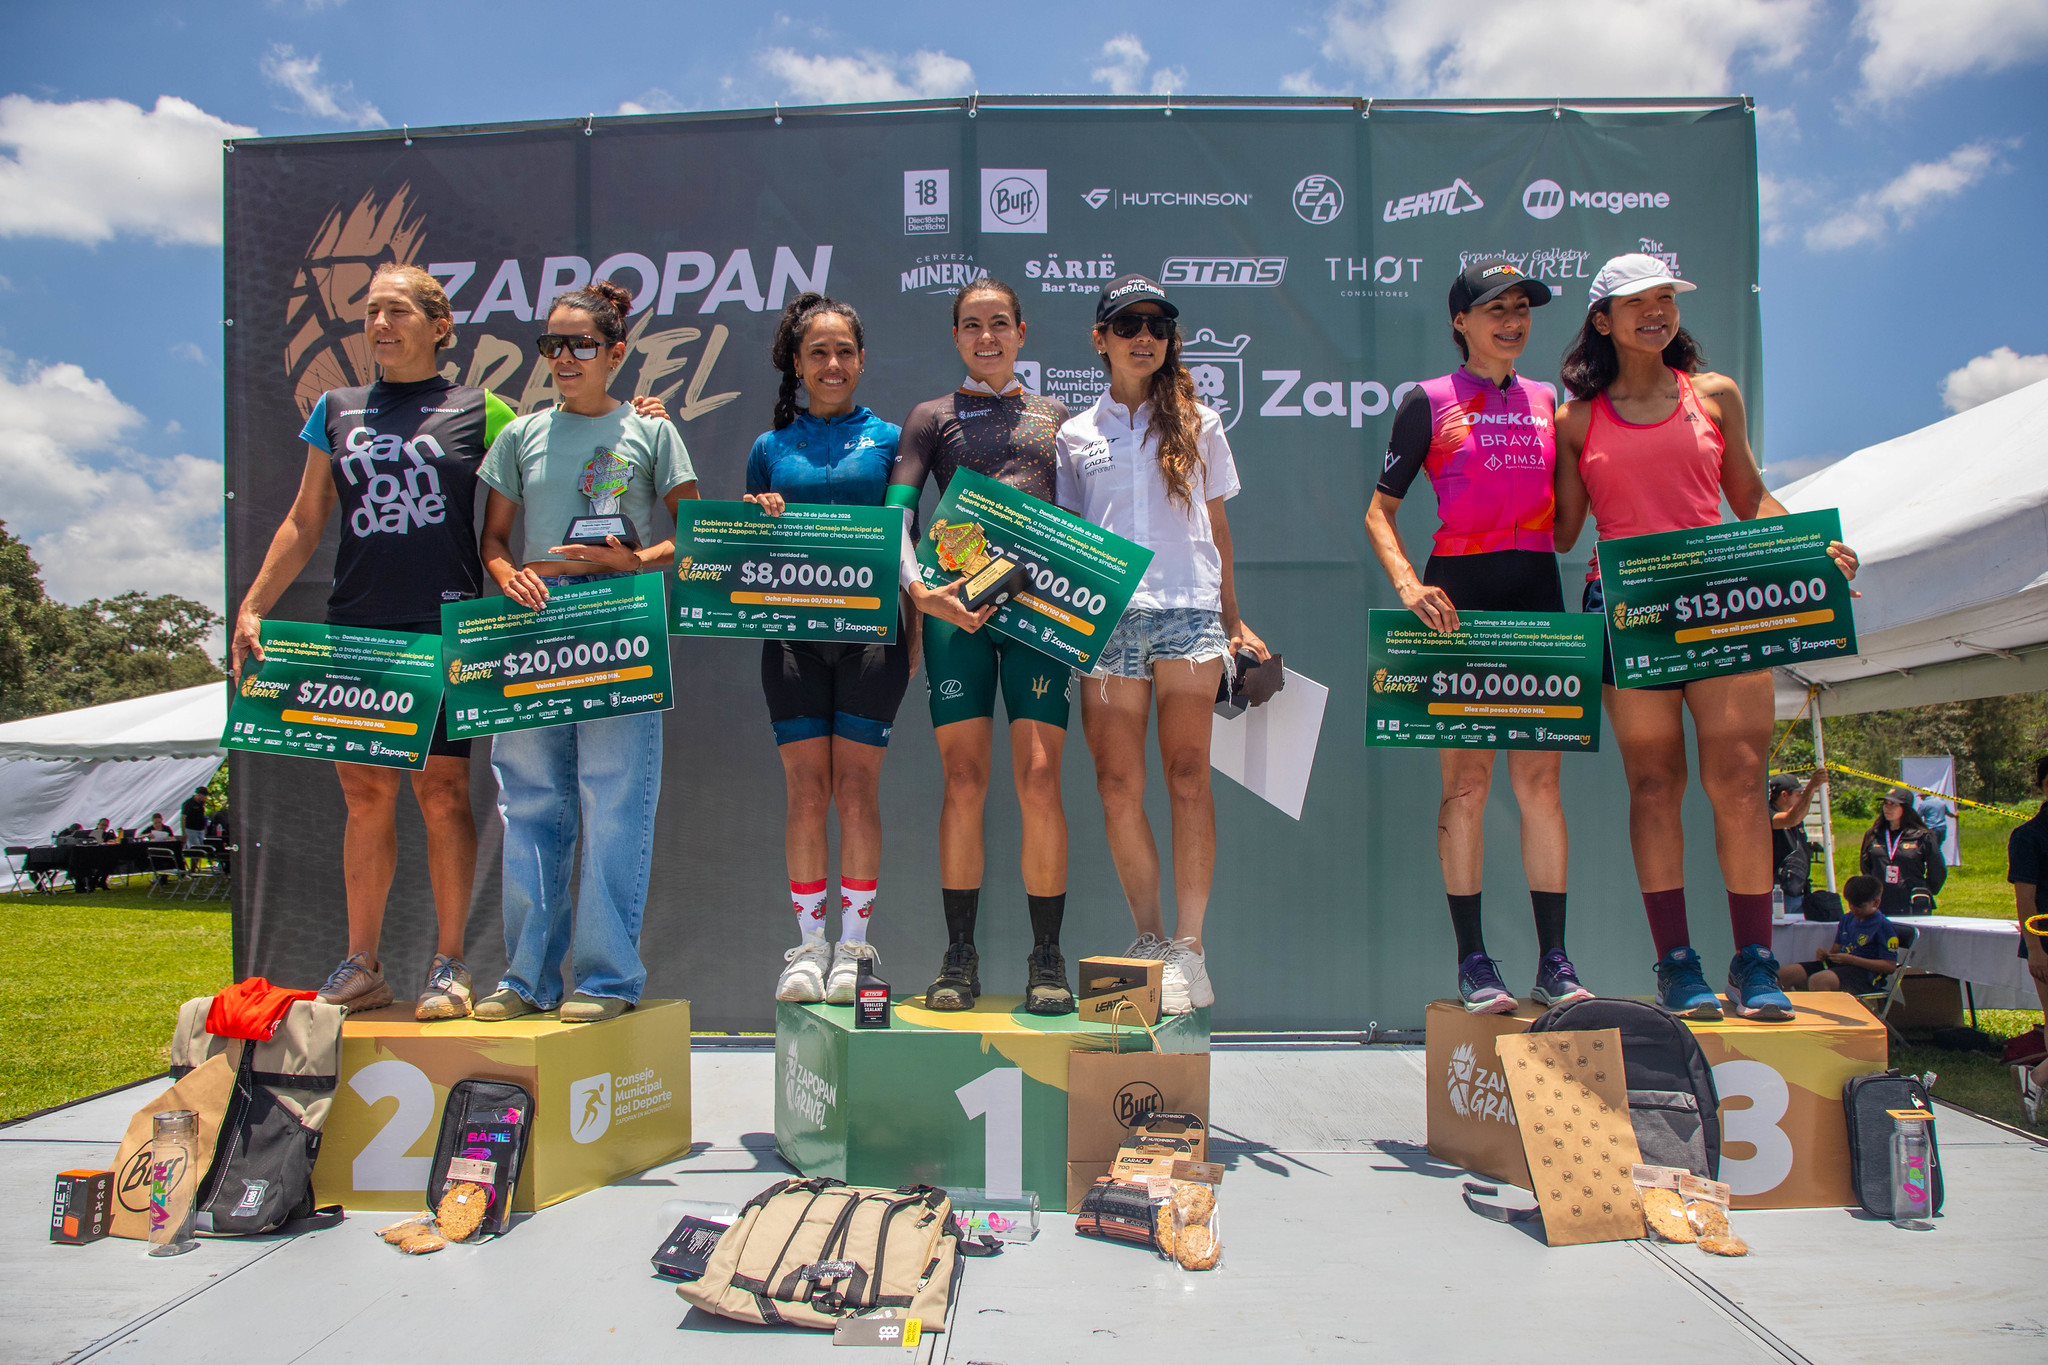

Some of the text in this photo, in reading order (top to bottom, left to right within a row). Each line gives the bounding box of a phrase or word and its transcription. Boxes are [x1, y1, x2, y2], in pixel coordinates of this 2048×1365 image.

[1123, 193, 1248, 206] HUTCHINSON
[1570, 190, 1670, 214] Magene
[916, 253, 974, 263] CERVEZA
[1532, 248, 1590, 260] Galletas
[1025, 253, 1116, 279] SÄRIË
[1164, 260, 1285, 284] STANS
[1325, 256, 1423, 283] THOT
[427, 245, 833, 324] ZAPOPAN
[901, 264, 989, 293] MINERVA
[1042, 284, 1100, 294] Bar Tape
[1046, 367, 1104, 379] Consejo
[1047, 380, 1112, 392] Municipa
[340, 408, 379, 417] SHIMANO
[1481, 434, 1544, 447] BRAVA
[1505, 454, 1546, 466] PIMSA
[1706, 533, 1732, 542] Domingo
[1732, 531, 1741, 539] 26
[1739, 530, 1748, 538] de
[1748, 528, 1760, 536] julio
[1770, 524, 1784, 533] 2026
[1619, 566, 1646, 575] Deporte
[1657, 560, 1689, 569] Zapopan,
[1704, 555, 1726, 563] otorga
[1734, 549, 1764, 559] presente
[1765, 546, 1791, 554] cheque
[1792, 541, 1825, 550] simbólico
[1626, 556, 1660, 566] Gobierno
[1672, 550, 1707, 560] Zapopan,
[1748, 540, 1775, 549] Consejo
[1776, 535, 1809, 544] Municipal
[688, 569, 721, 581] GRAVEL
[691, 563, 731, 572] ZAPOPAN
[741, 562, 872, 587] $8,000.00
[1714, 576, 1739, 585] cantidad
[1676, 578, 1826, 620] $13,000.00
[1625, 603, 1669, 617] ZAPOPAN
[1623, 612, 1661, 627] GRAVEL
[1729, 624, 1740, 632] mil
[1740, 623, 1759, 631] pesos
[1759, 618, 1783, 627] 00/100
[503, 636, 648, 675] $20,000.00
[461, 660, 500, 673] ZAPOPAN
[459, 668, 492, 682] GRAVEL
[1386, 674, 1428, 683] ZAPOPAN
[249, 686, 279, 698] GRAVEL
[253, 680, 289, 690] ZAPOPAN
[1383, 681, 1417, 693] GRAVEL
[1433, 672, 1580, 698] $10,000.00
[297, 681, 412, 713] $7,000.00
[615, 1067, 654, 1088] Consejo
[615, 1078, 662, 1103] Municipal
[797, 1064, 838, 1108] ZAPOPAN
[615, 1090, 672, 1116] del Deporte
[795, 1085, 827, 1131] GRAVEL
[348, 1060, 435, 1191] 2
[955, 1067, 1022, 1200] 1
[1714, 1060, 1794, 1195] 3
[467, 1130, 511, 1142] SÄRIË
